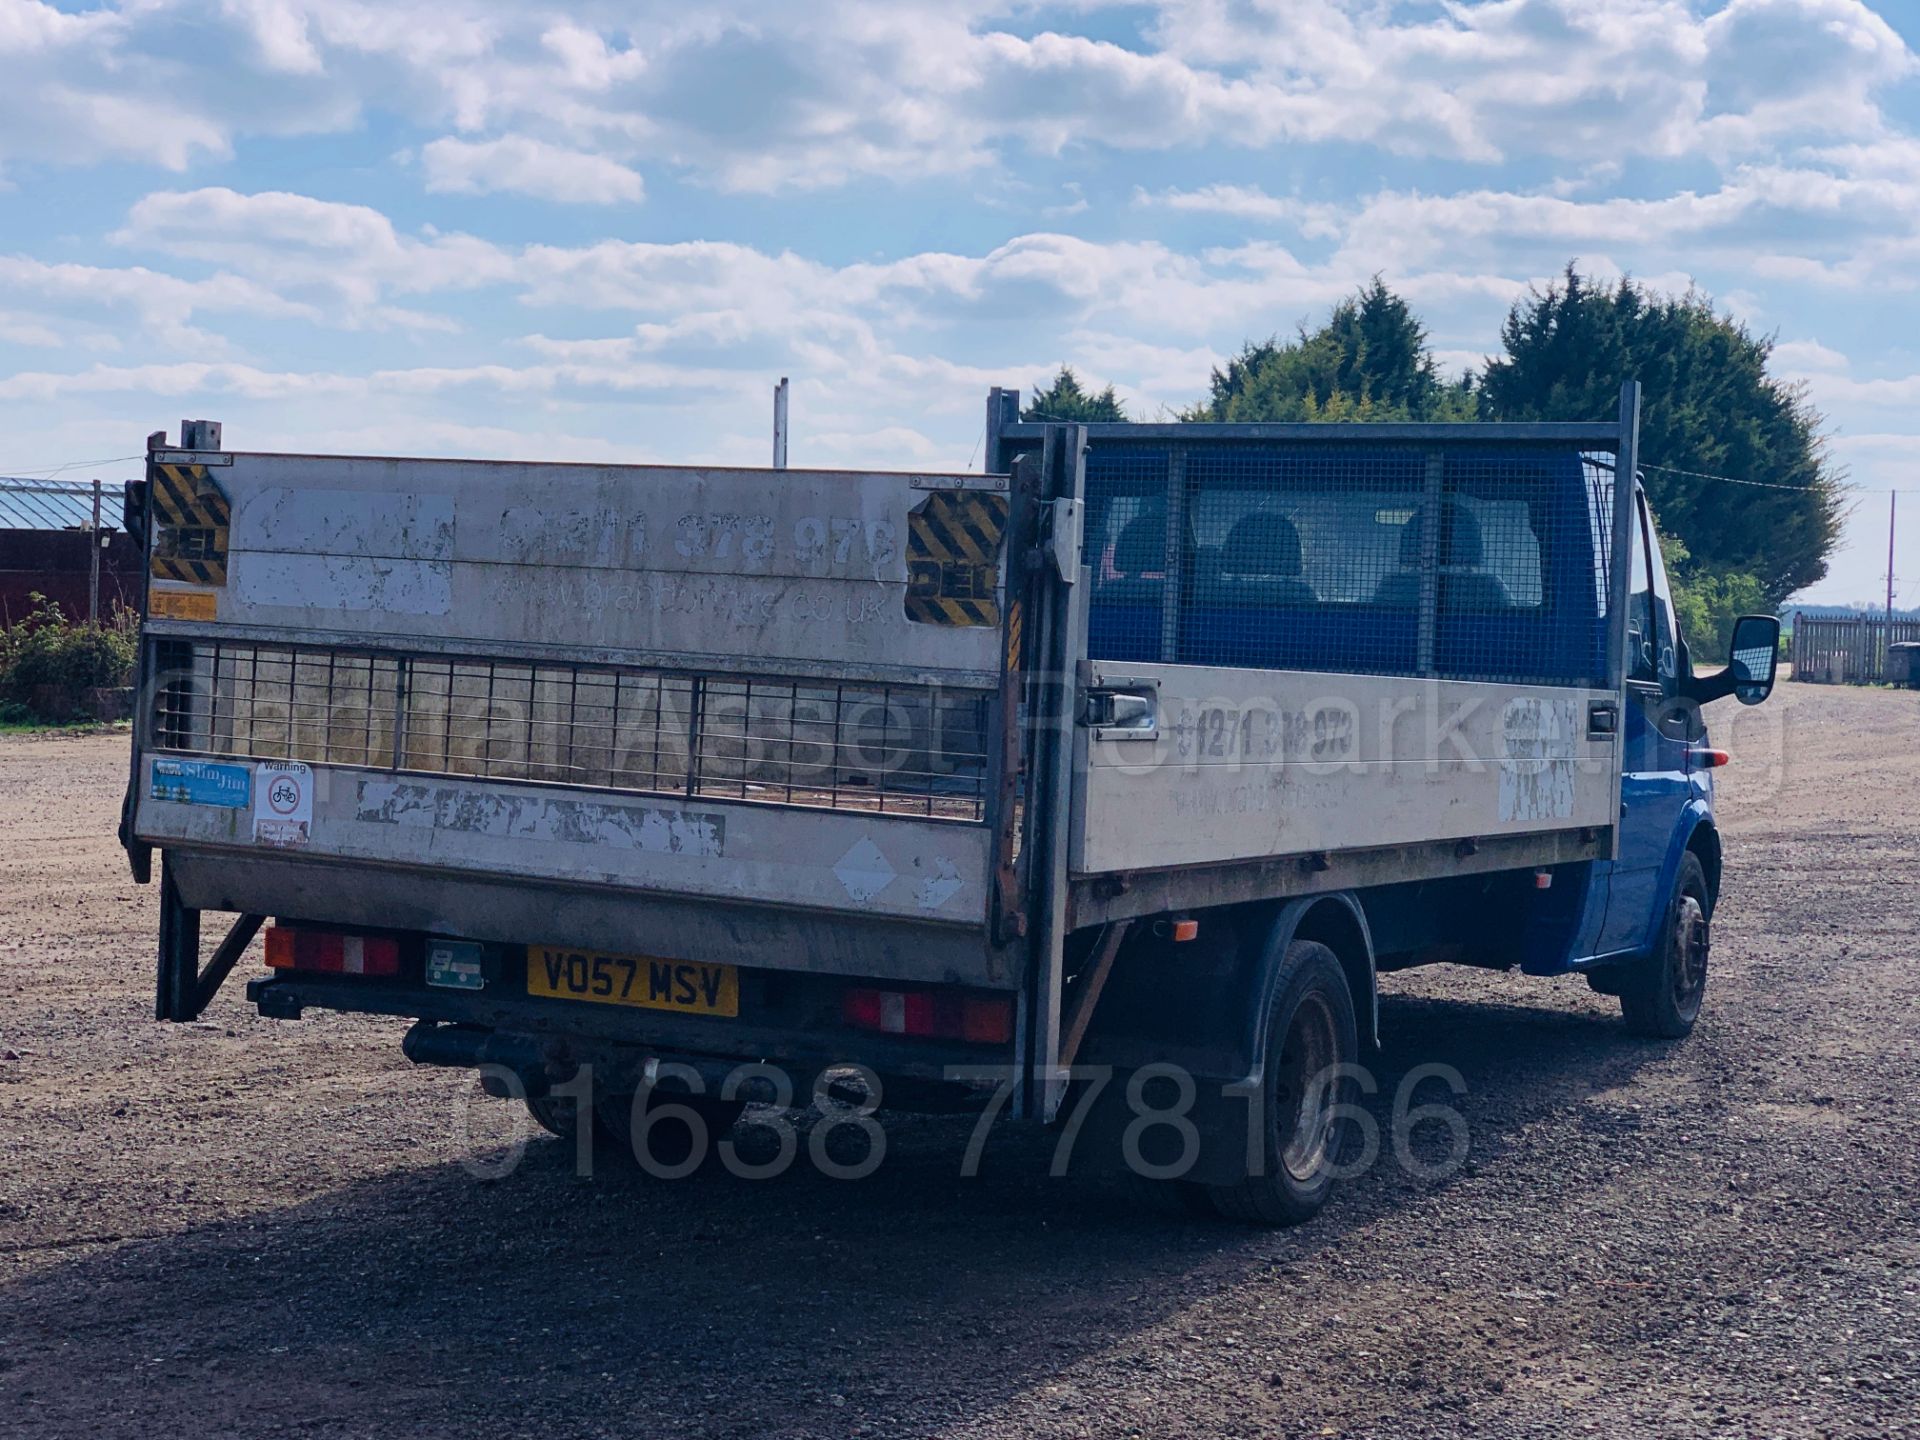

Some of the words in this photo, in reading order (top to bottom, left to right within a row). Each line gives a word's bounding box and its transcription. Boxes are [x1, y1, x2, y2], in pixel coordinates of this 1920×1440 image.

[185, 763, 220, 780] Slim
[217, 775, 246, 791] Jim
[264, 761, 307, 774] Warning
[543, 951, 637, 998] VO57
[650, 961, 722, 1008] MSV
